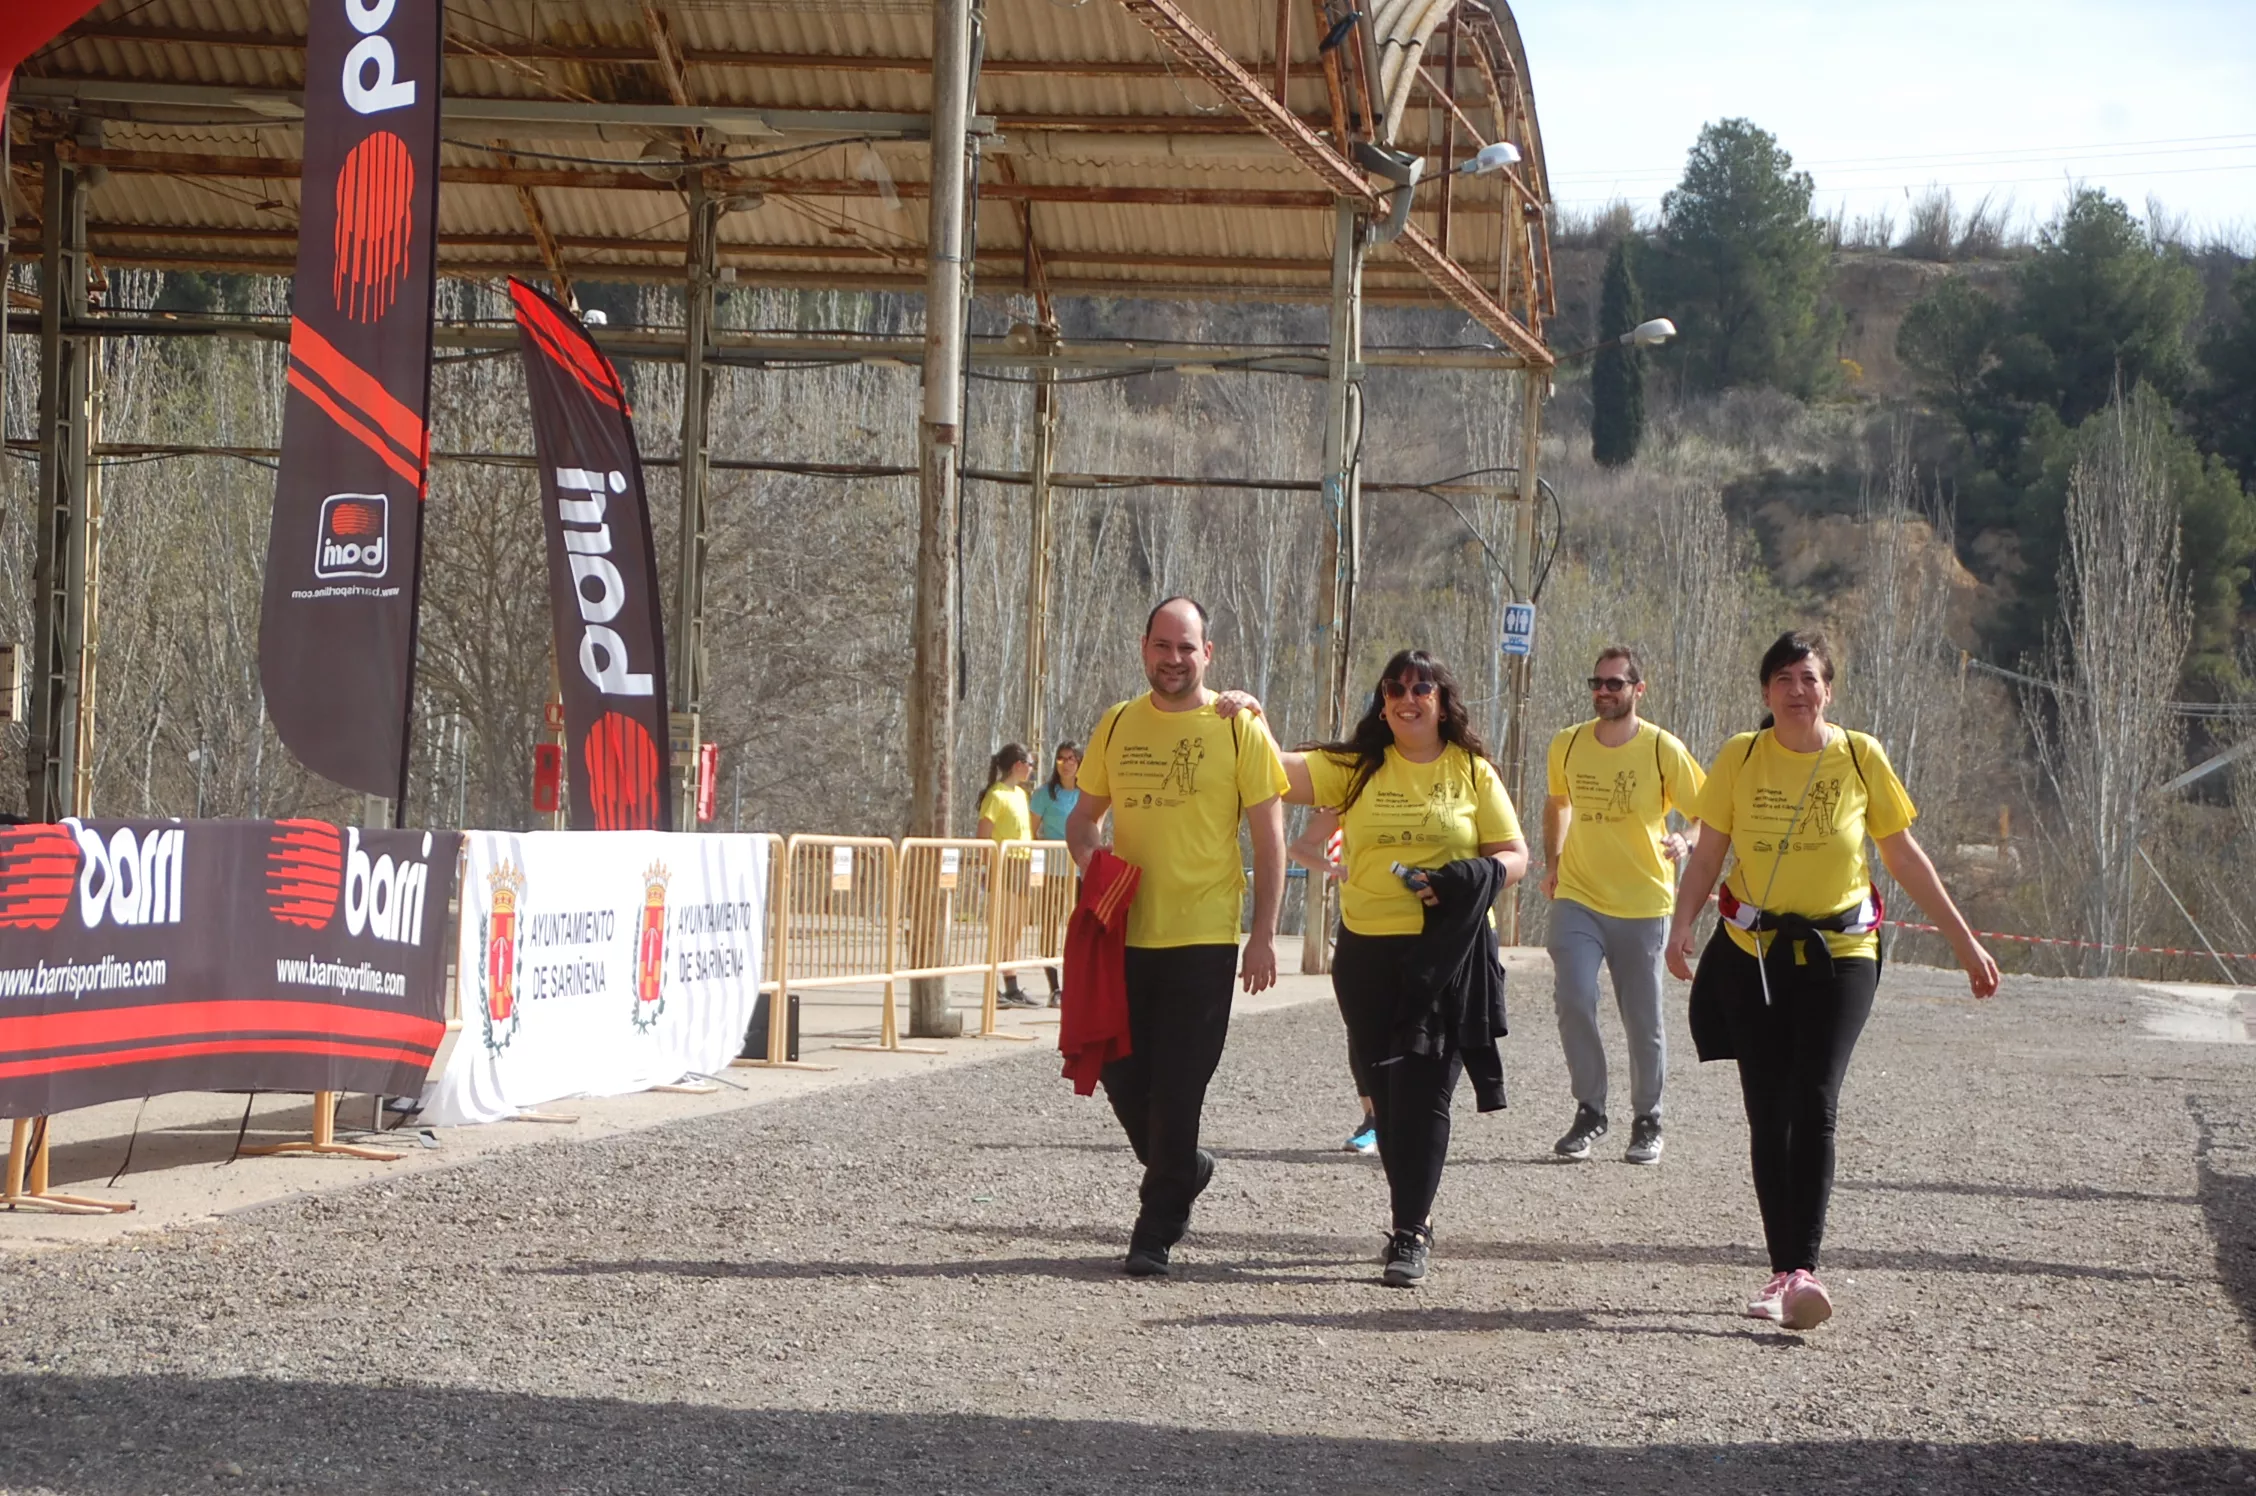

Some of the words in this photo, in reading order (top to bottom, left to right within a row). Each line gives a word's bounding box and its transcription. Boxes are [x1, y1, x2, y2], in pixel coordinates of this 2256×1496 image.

[59, 817, 184, 928] barri
[345, 826, 433, 946] barri
[530, 908, 615, 947] AYUNTAMIENTO
[676, 902, 751, 936] AYUNTAMIENTO
[276, 954, 406, 996] www.barrisportline.com
[533, 965, 547, 1000] DE
[679, 952, 692, 983] DE
